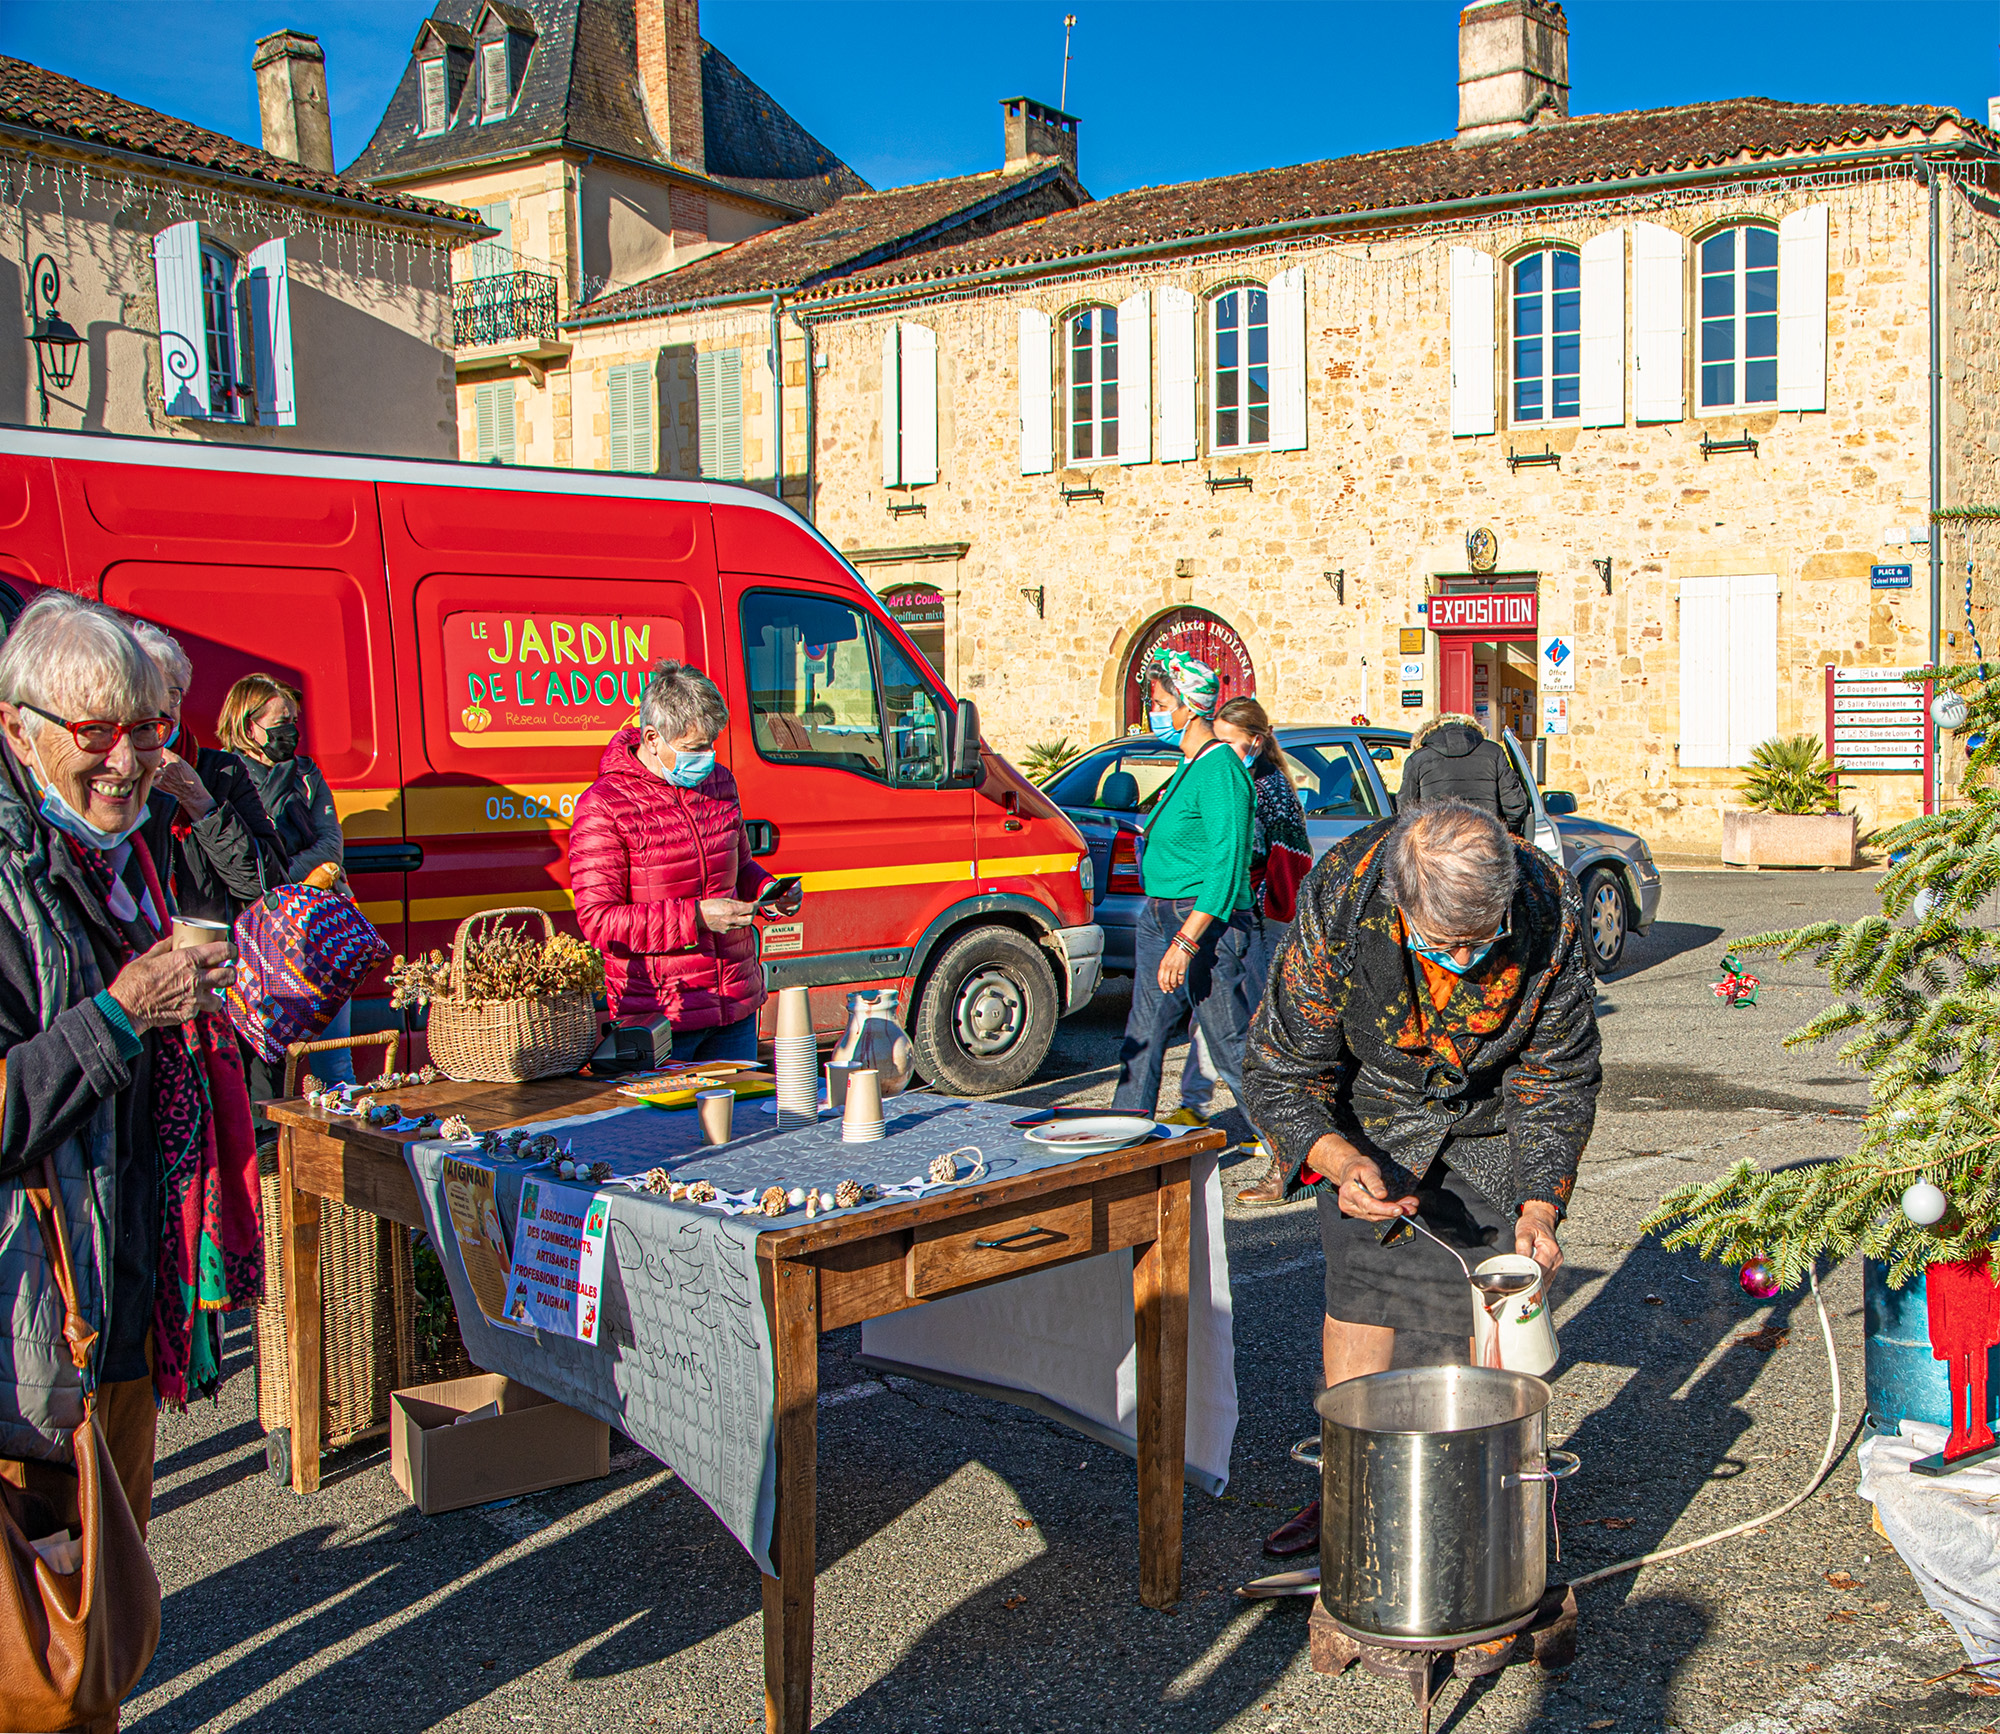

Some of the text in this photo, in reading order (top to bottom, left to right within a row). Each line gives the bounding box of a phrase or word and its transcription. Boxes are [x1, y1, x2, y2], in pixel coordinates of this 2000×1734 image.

[888, 595, 903, 607] Art
[905, 594, 912, 606] &
[895, 610, 924, 622] coiffure
[470, 619, 650, 665] LE JARDIN
[1136, 620, 1252, 684] Coiffure Mixte INDIANA
[468, 670, 657, 706] DE L'ADOU
[505, 712, 606, 730] Réseau Cocagne
[447, 1161, 490, 1189] AIGNAN
[540, 1208, 585, 1230] ASSOCIATION
[527, 1225, 593, 1256] DES COMMERÇANTS,
[536, 1249, 579, 1272] ARTISANS ET
[514, 1264, 597, 1299] PROFESSIONS LIBÉRALES
[536, 1291, 570, 1312] D'AIGNAN
